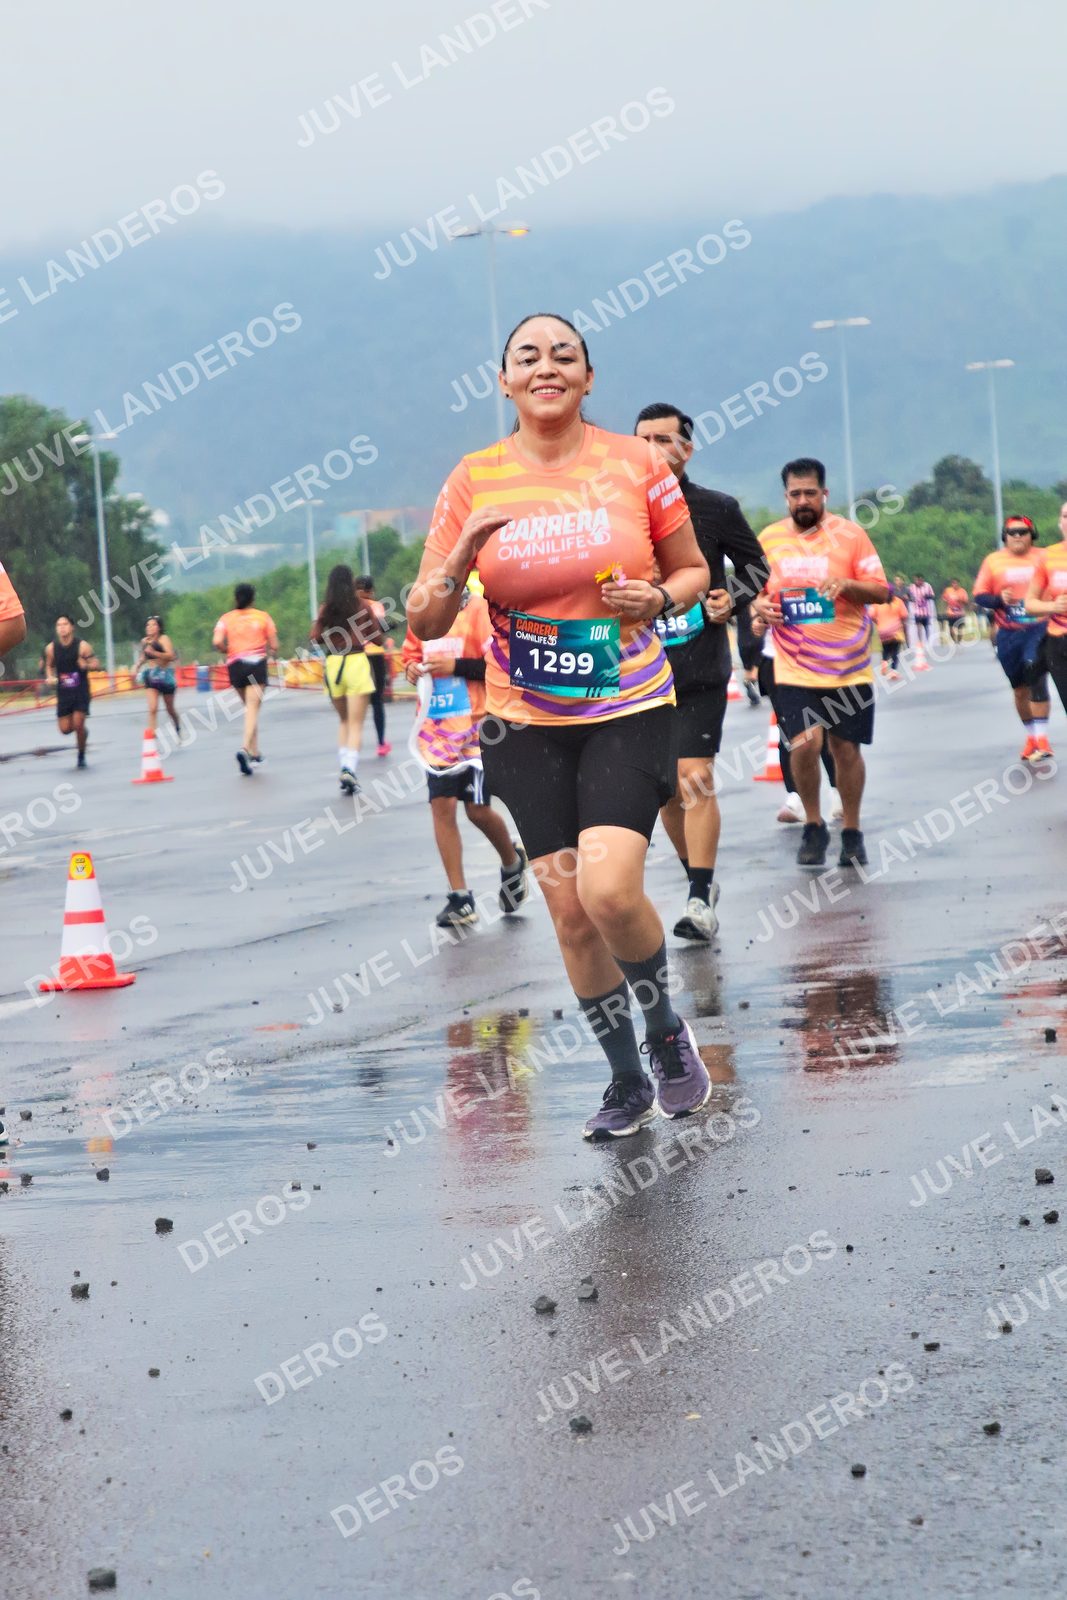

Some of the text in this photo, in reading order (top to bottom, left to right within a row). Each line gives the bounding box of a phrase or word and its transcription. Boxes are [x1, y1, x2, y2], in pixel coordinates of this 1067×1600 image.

[499, 507, 609, 542] CARRERA
[498, 534, 587, 560] OMNILIFE
[790, 602, 823, 615] 1104
[515, 619, 611, 640] CARRERA 10K
[653, 614, 688, 634] 536
[515, 630, 548, 645] OMNILIFE
[529, 648, 594, 675] 1299
[429, 693, 454, 708] 757
